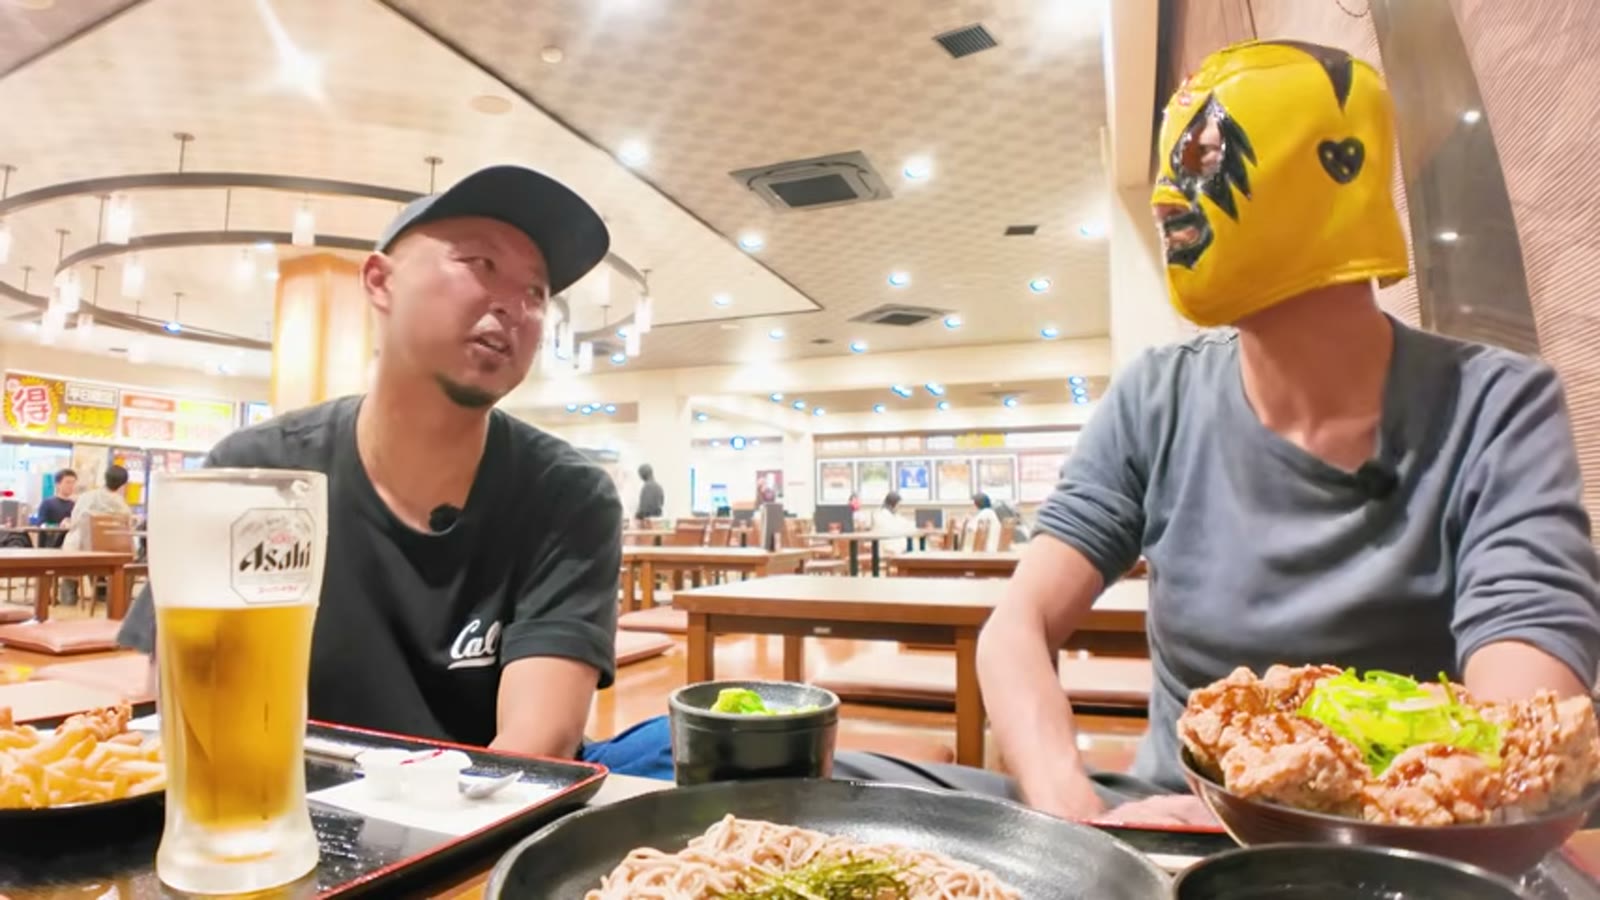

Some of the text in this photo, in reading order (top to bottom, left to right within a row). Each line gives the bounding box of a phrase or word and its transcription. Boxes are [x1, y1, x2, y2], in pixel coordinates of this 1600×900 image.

[13, 386, 49, 424] 得
[239, 541, 311, 572] Asahi
[450, 619, 501, 660] Cal
